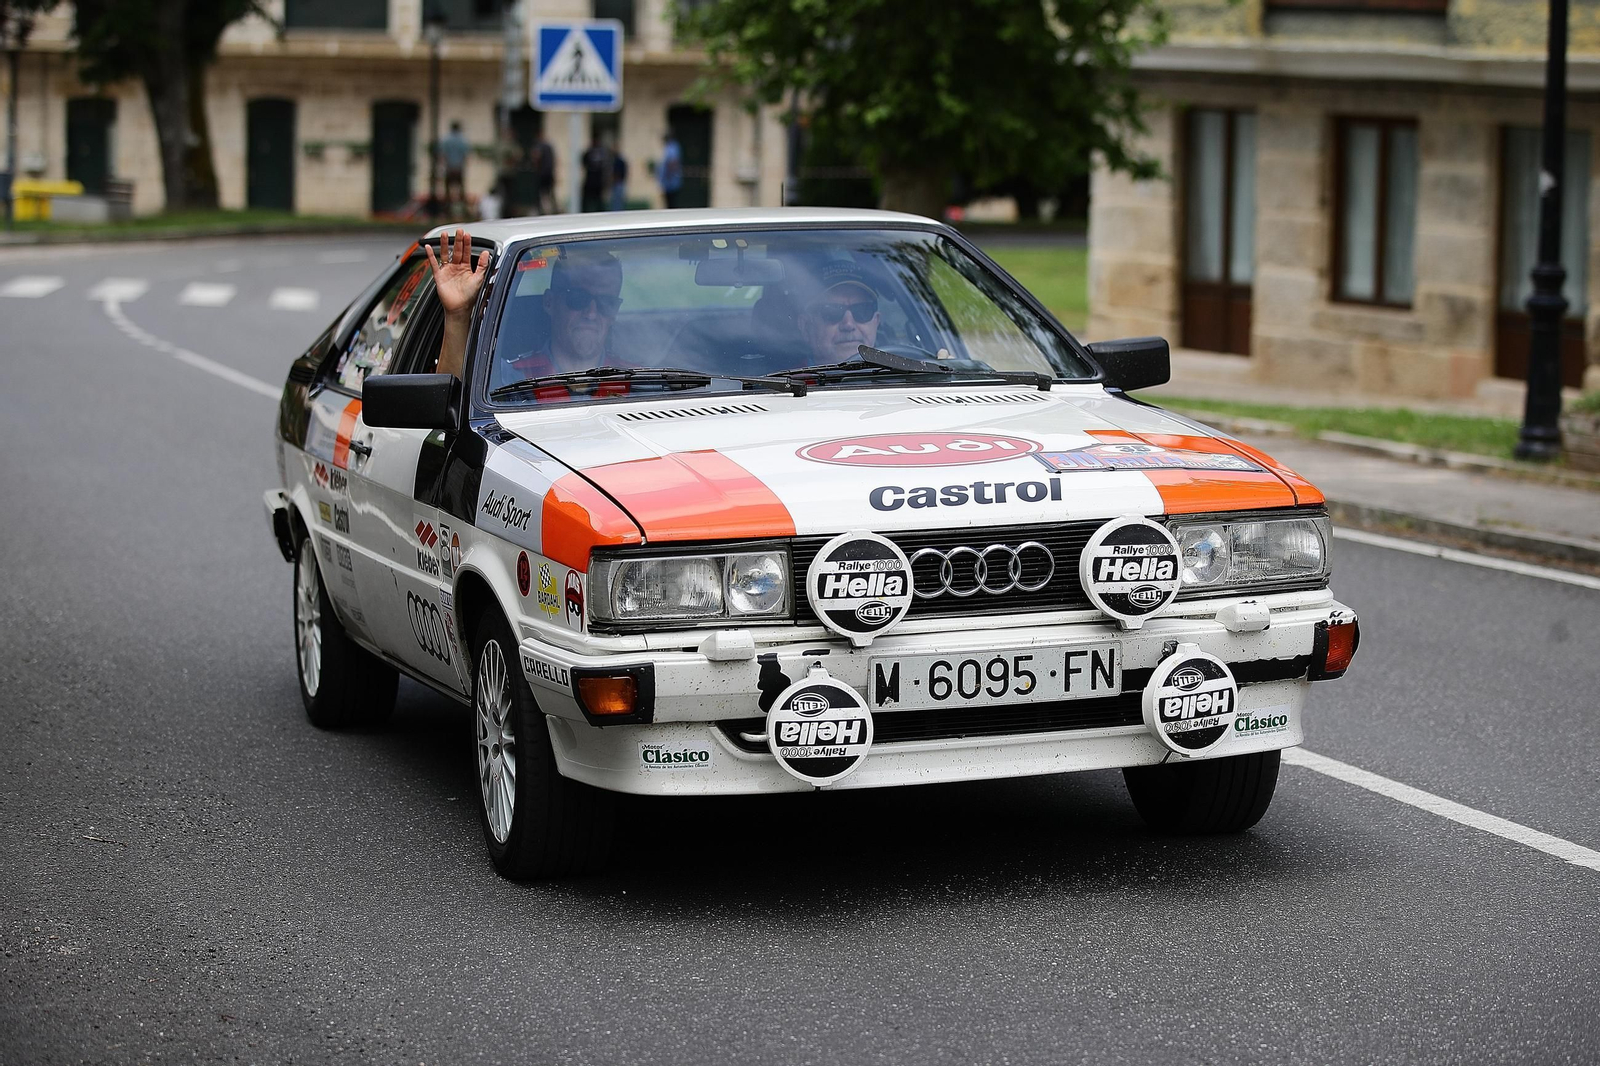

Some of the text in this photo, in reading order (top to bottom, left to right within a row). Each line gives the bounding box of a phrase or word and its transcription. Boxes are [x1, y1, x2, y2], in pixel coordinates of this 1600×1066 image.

[481, 489, 533, 531] Audi Sport
[1113, 544, 1174, 555] Rallye 1000
[838, 560, 903, 571] Rallye 1000
[1098, 557, 1174, 581] Hella
[823, 572, 903, 598] Hella
[537, 590, 561, 609] BARDAHL
[1131, 590, 1163, 600] HELLA
[858, 606, 892, 617] HELLA
[523, 655, 570, 687] CARELLO
[928, 655, 1037, 700] 6095
[1173, 676, 1202, 687] HELLA
[792, 700, 826, 712] HELLA
[1164, 690, 1230, 719] Hella
[1163, 717, 1220, 733] Rallye 1000
[1234, 714, 1288, 732] Clásico
[780, 721, 861, 745] Hella
[642, 749, 710, 764] Clásico
[780, 747, 847, 757] Rallye 1000
